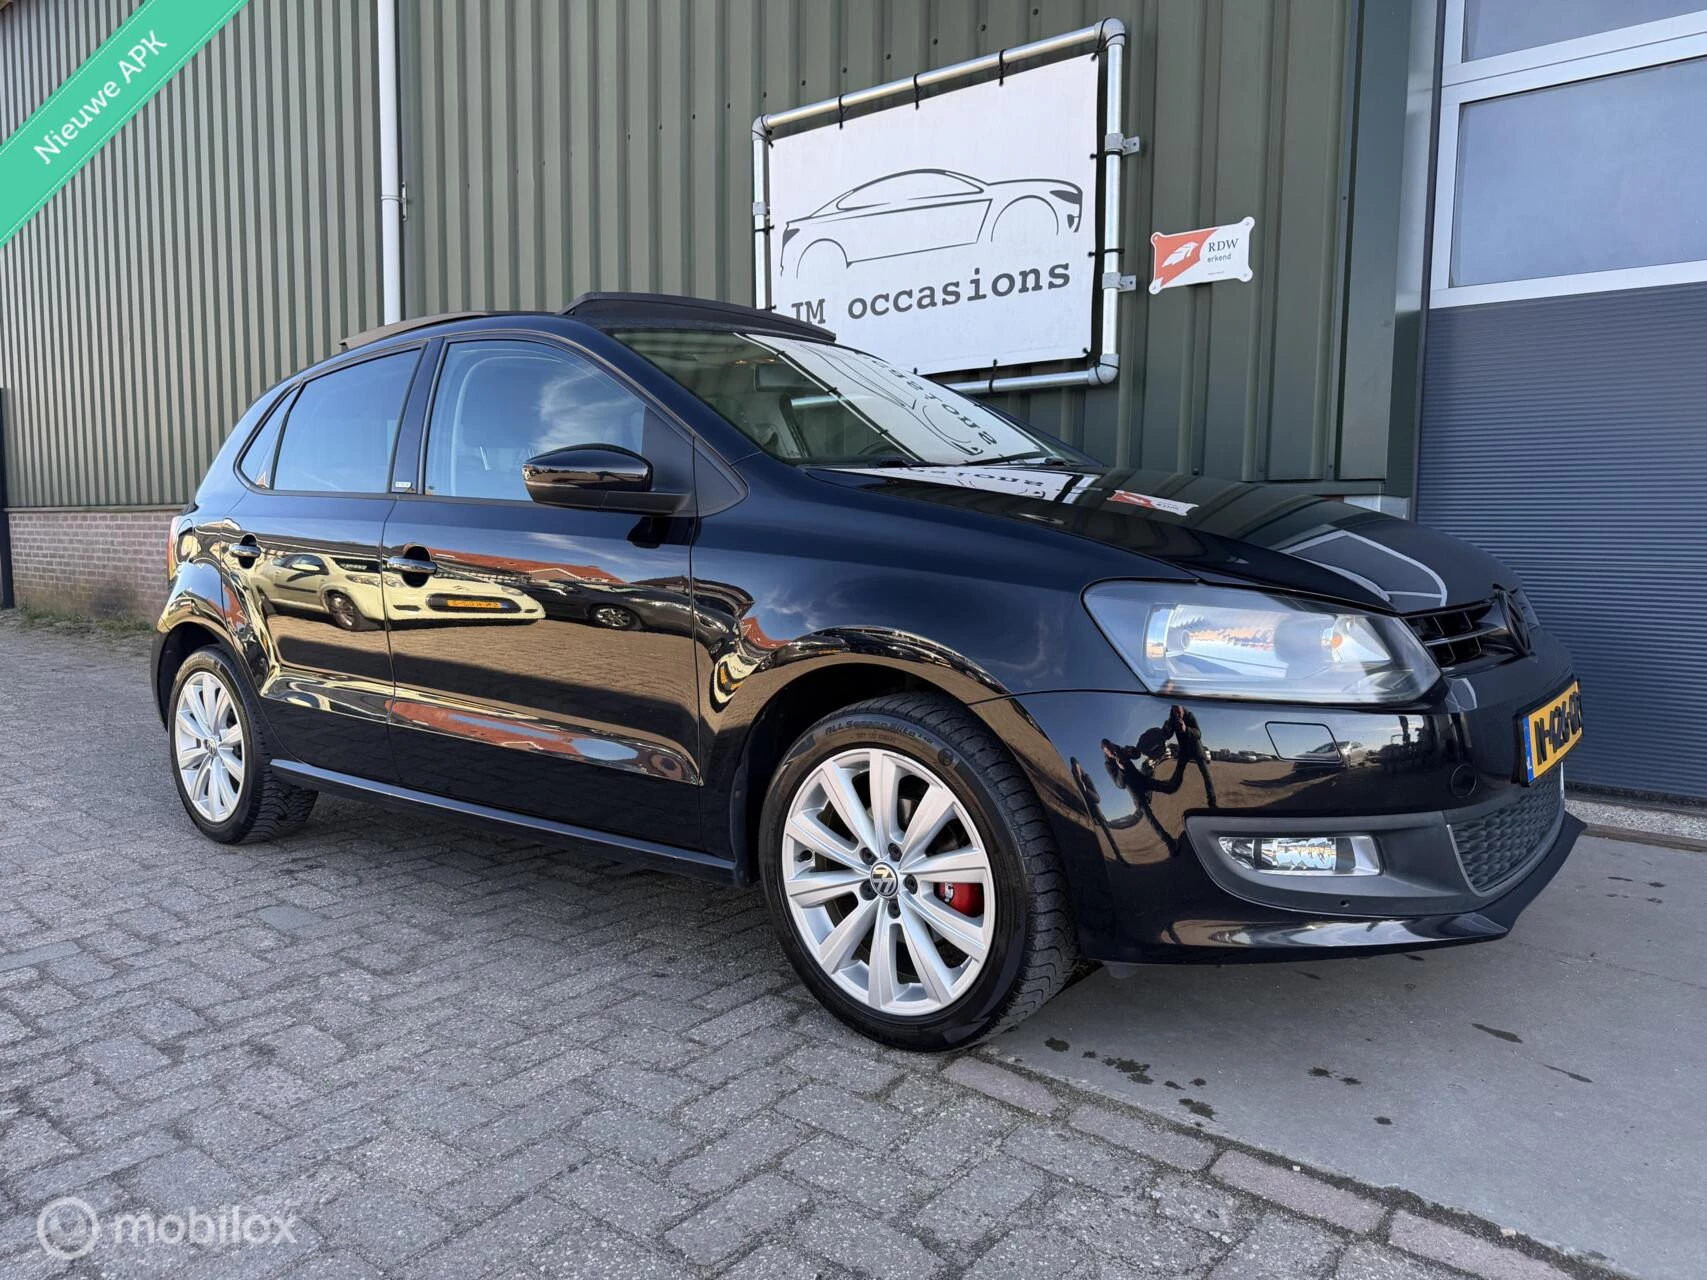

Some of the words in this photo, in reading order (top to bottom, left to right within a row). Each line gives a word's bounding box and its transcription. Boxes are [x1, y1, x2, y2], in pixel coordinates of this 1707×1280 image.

[1208, 238, 1240, 253] RDW
[1207, 252, 1232, 263] erkend
[847, 262, 1071, 320] occasions
